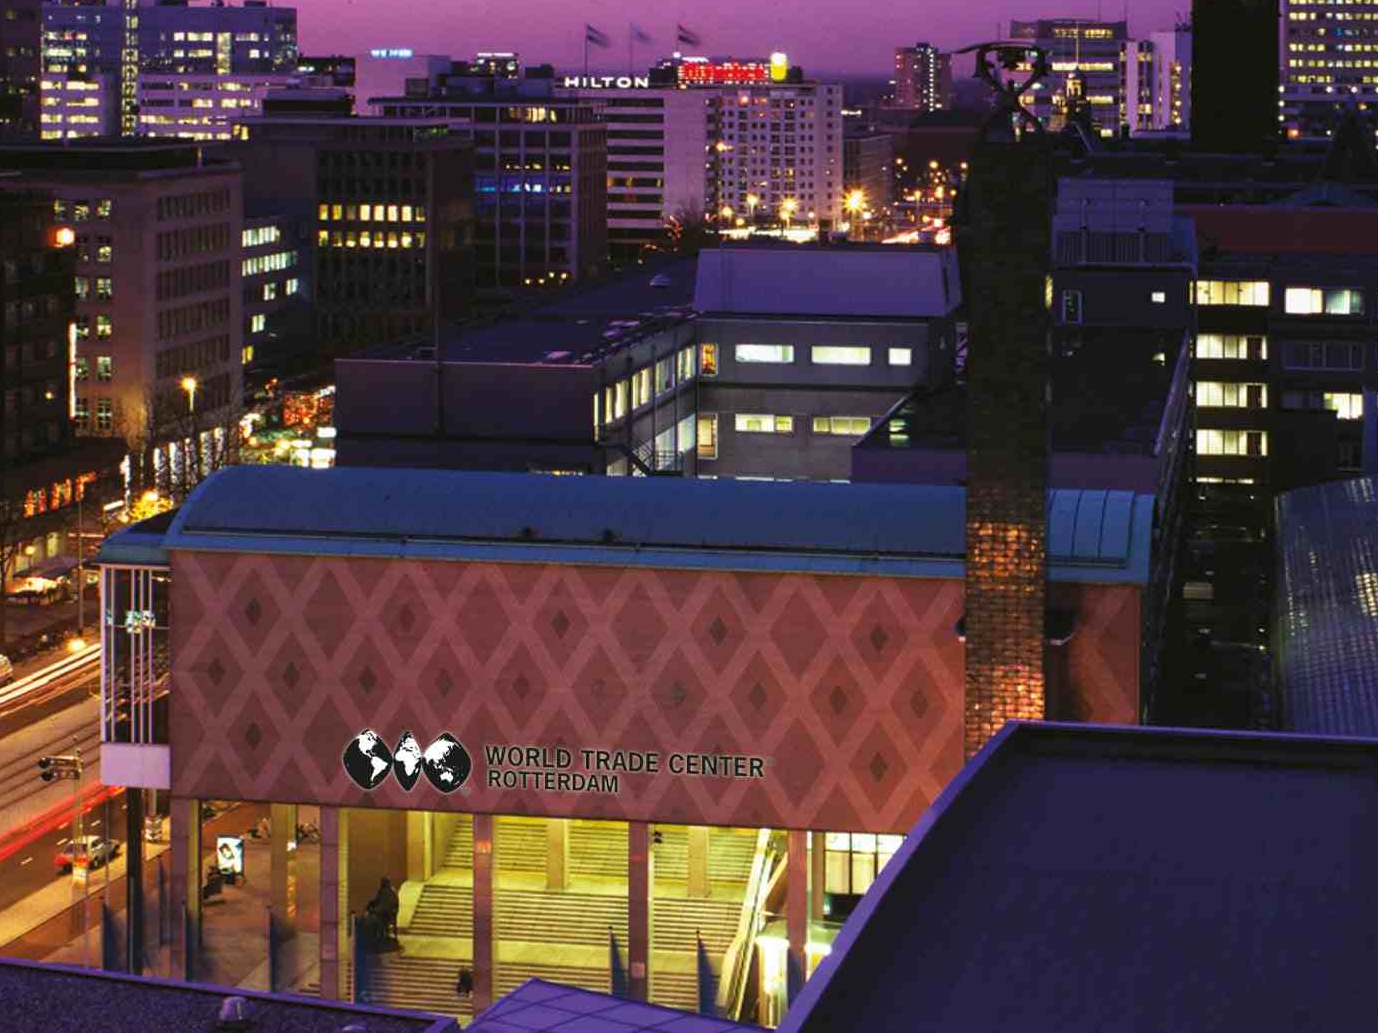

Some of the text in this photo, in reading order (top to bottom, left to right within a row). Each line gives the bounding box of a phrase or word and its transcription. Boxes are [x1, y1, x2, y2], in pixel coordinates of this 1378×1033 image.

[564, 76, 649, 89] HILTON
[485, 745, 765, 778] WORLD TRADE CENTER
[488, 769, 619, 793] ROTTERDAM
